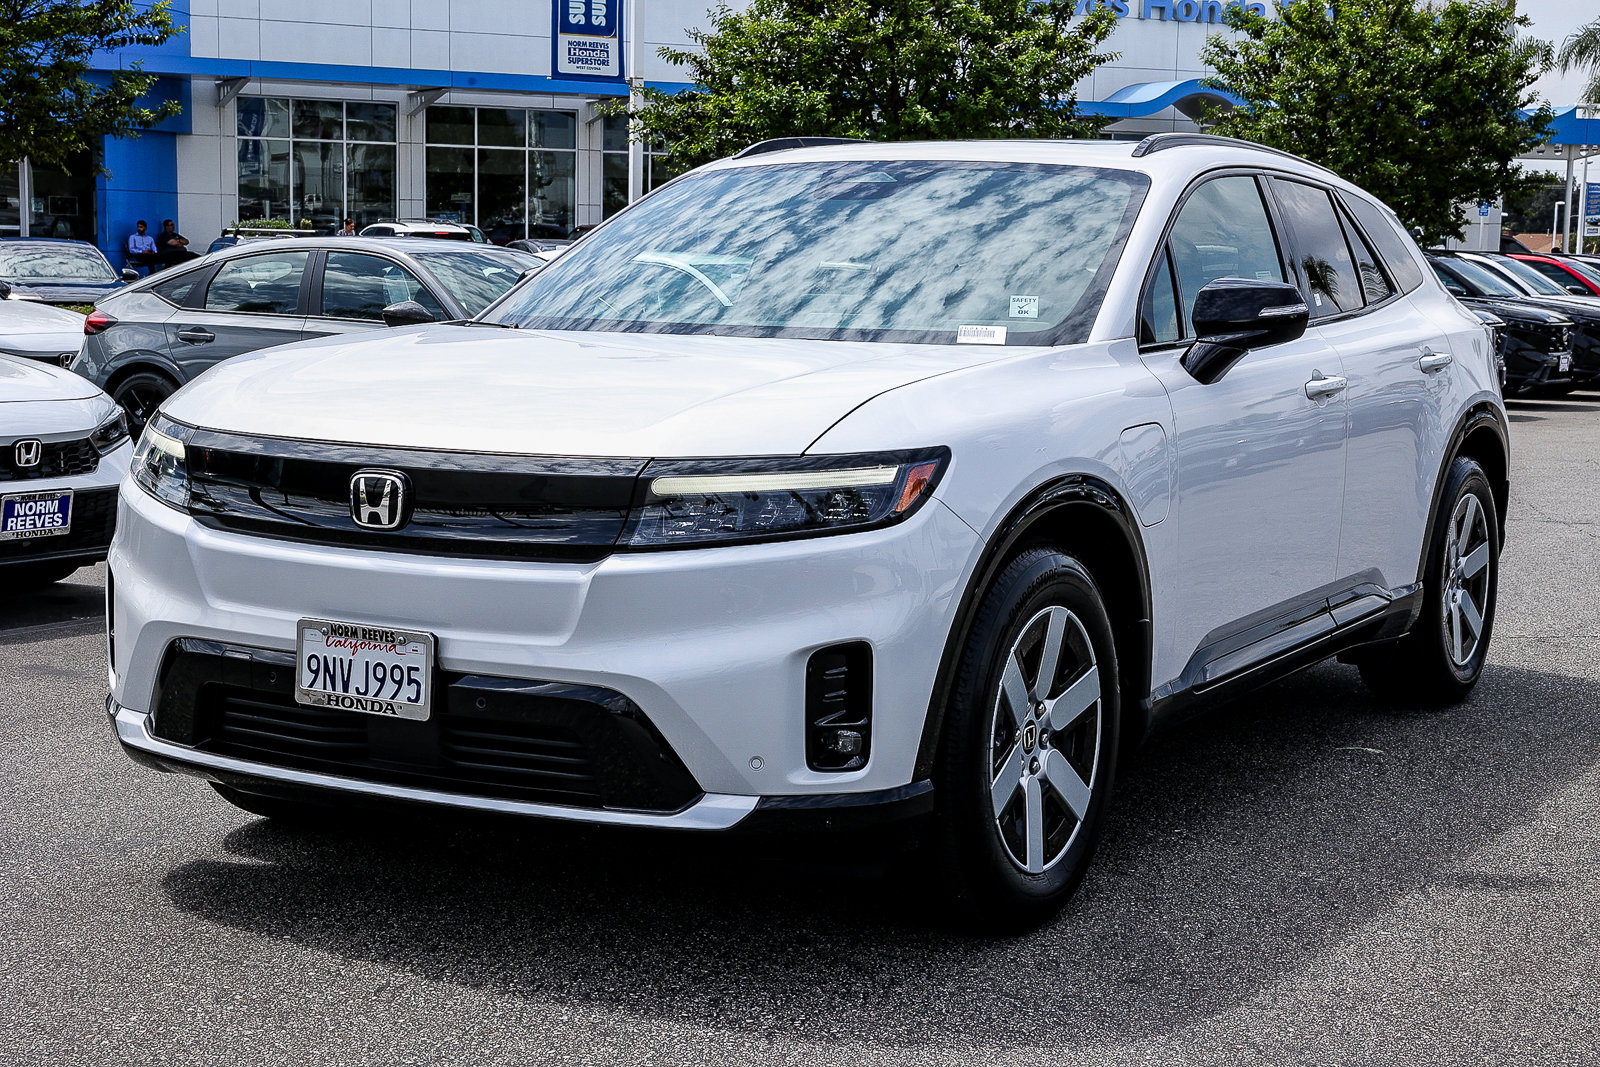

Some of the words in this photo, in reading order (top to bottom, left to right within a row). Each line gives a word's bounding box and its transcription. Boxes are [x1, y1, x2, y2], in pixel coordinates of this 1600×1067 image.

[569, 0, 586, 25] SU
[592, 0, 607, 27] SU
[568, 40, 587, 48] NORM
[570, 48, 608, 58] Honda
[568, 57, 610, 66] SUPERSTORE
[14, 500, 59, 516] NORM
[7, 513, 63, 531] REEVES
[15, 529, 54, 538] HONDA
[331, 624, 359, 639] NORM
[362, 628, 396, 643] REEVES
[325, 635, 406, 656] California
[307, 653, 422, 704] 9NVJ995
[327, 693, 398, 715] HONDA
